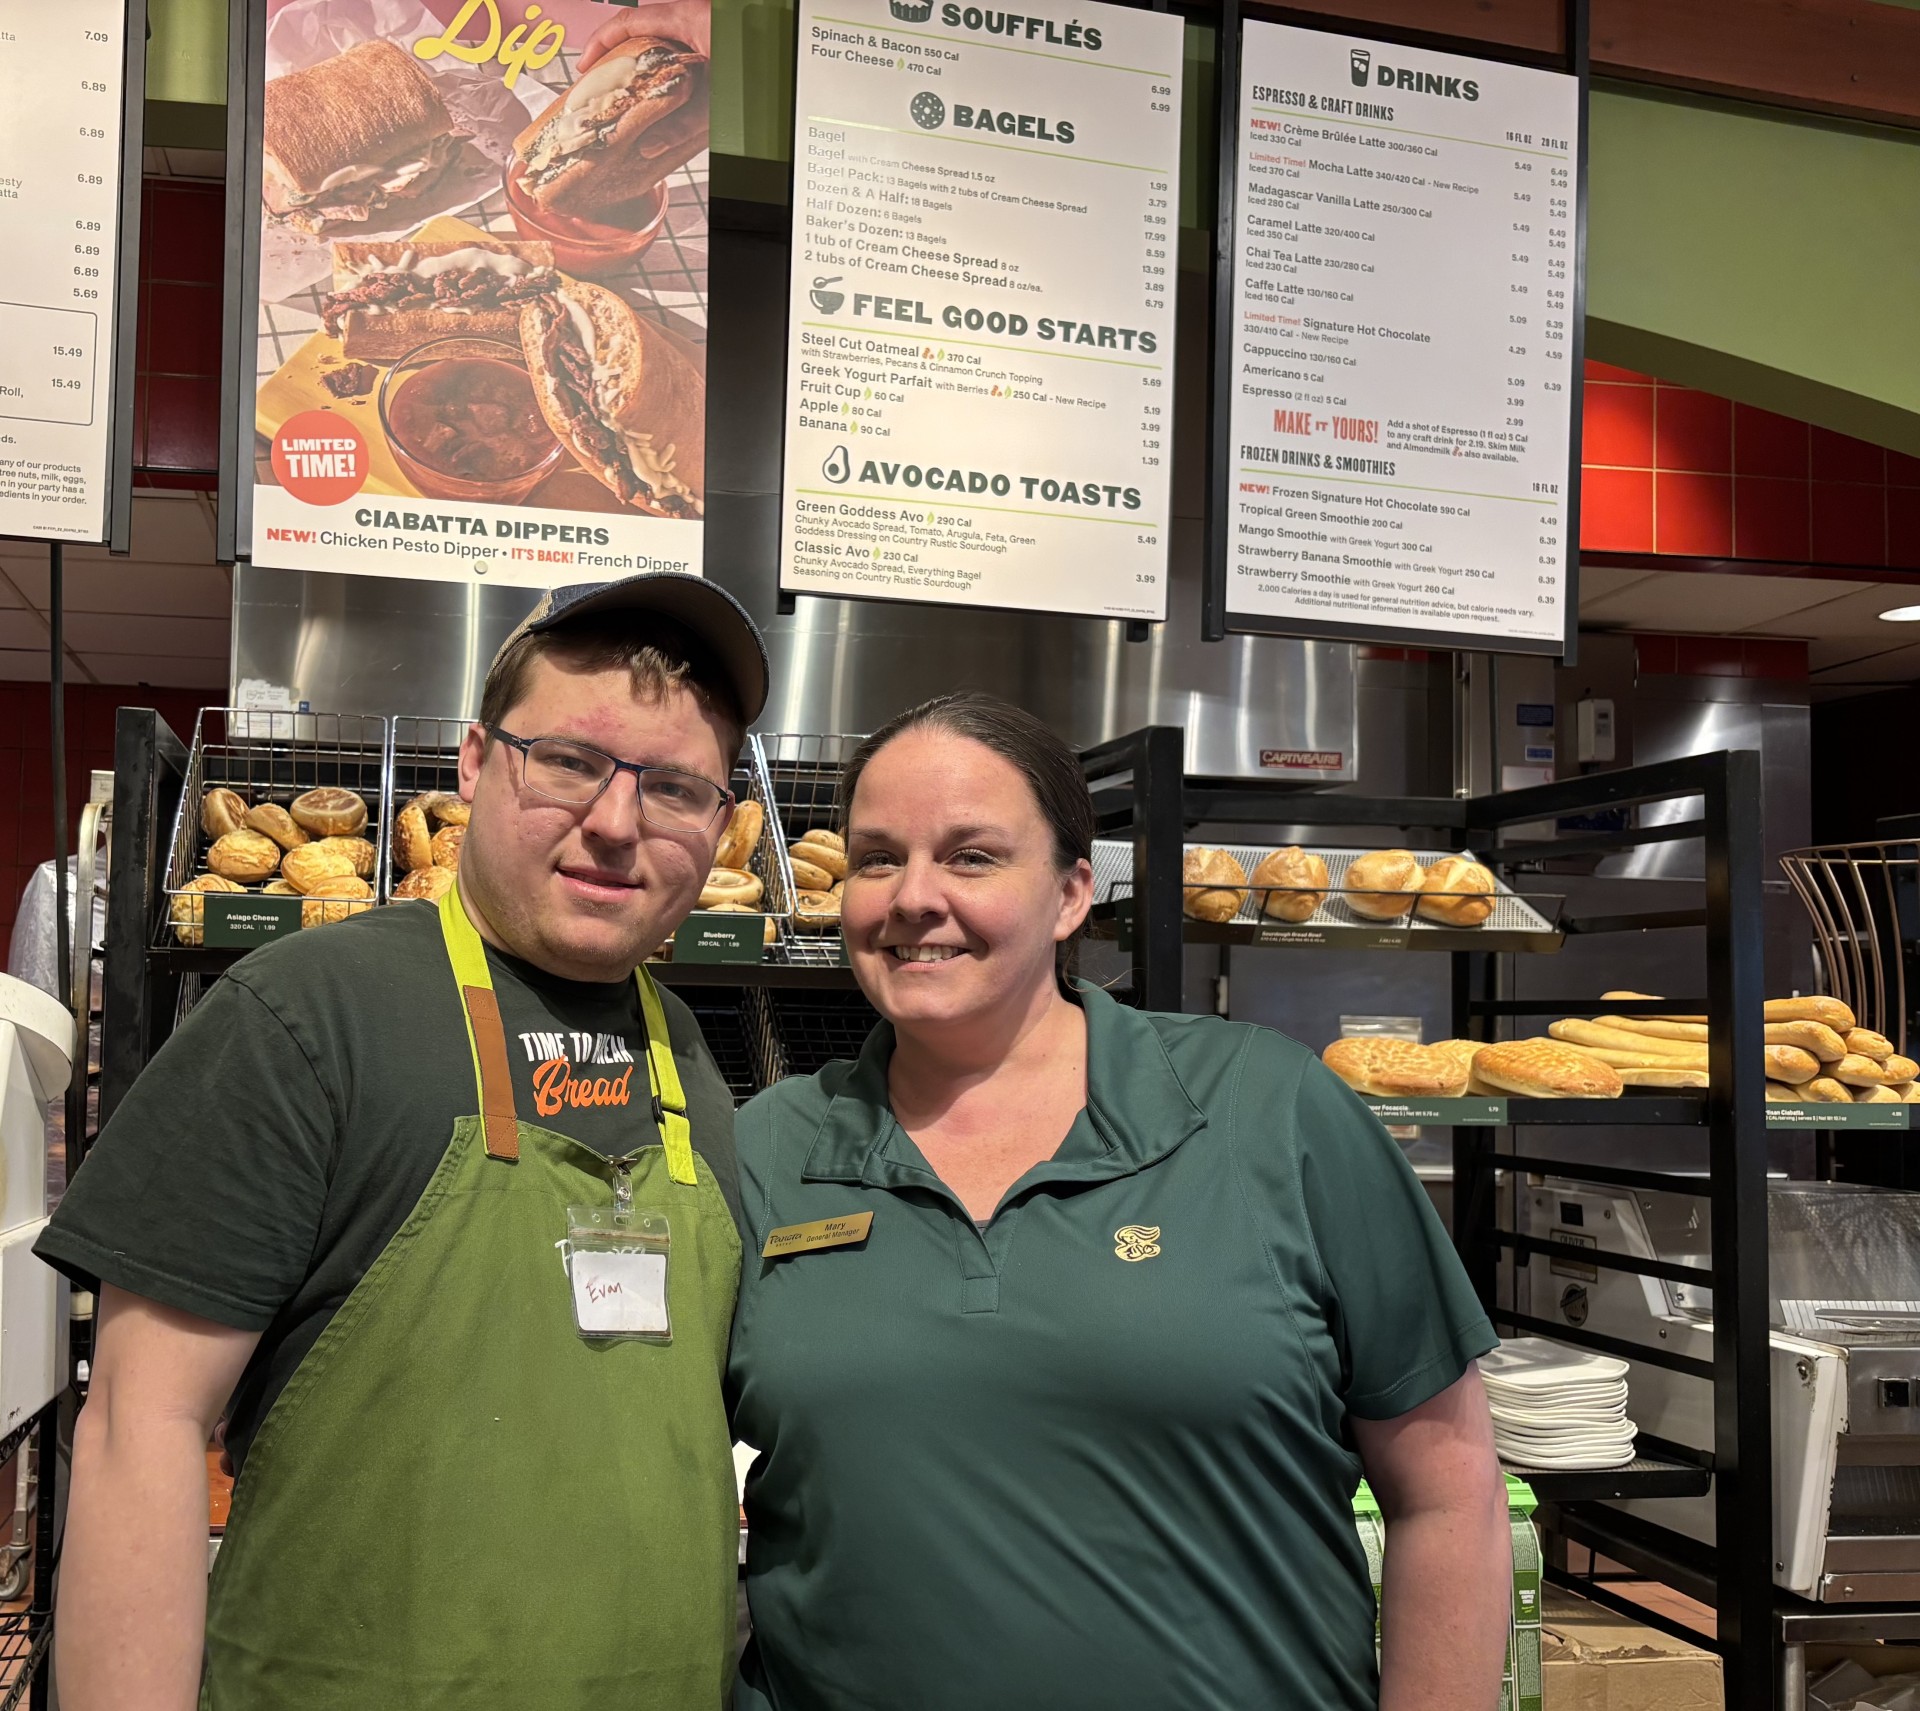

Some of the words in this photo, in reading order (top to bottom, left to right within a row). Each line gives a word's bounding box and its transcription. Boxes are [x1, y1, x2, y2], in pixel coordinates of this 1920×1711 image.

[941, 3, 1102, 51] SOUFFLÉS
[84, 30, 109, 43] 7.09
[811, 26, 864, 46] Spinach
[867, 35, 878, 48] &
[881, 37, 921, 55] Bacon
[924, 47, 942, 58] 550
[943, 51, 959, 61] Cal
[413, 0, 565, 90] Dip
[811, 43, 842, 59] Four
[844, 49, 894, 68] Cheese
[906, 62, 924, 73] 470
[925, 65, 942, 76] Cal
[81, 80, 107, 93] 6.89
[1151, 85, 1171, 96] 6.99
[1377, 64, 1479, 102] DRINKS
[1252, 85, 1305, 107] ESPRESSO
[1307, 94, 1318, 110] &
[1320, 96, 1353, 115] CRAFT
[1355, 101, 1394, 121] DRINKS
[953, 103, 1075, 144] BAGELS
[79, 127, 105, 139] 6.89
[1250, 118, 1281, 132] NEW!
[1283, 123, 1320, 138] Crème
[1358, 134, 1386, 149] Latte
[1424, 147, 1438, 157] Cal
[1514, 161, 1532, 172] 5.49
[1550, 167, 1568, 178] 6.49
[77, 173, 103, 185] 6.89
[75, 220, 101, 231] 6.89
[1247, 214, 1292, 230] Caramel
[1294, 220, 1322, 234] Latte
[1324, 227, 1360, 239] 320/400
[1361, 232, 1375, 242] Cal
[74, 244, 100, 256] 6.89
[805, 232, 810, 243] 1
[814, 233, 836, 246] tub
[838, 237, 853, 249] of
[855, 238, 898, 255] Cream
[901, 245, 950, 262] Cheese
[952, 252, 998, 269] Spread
[1008, 264, 1019, 272] oz
[73, 266, 99, 277] 6.89
[73, 287, 98, 299] 5.69
[853, 292, 933, 325] FEEL
[941, 305, 1028, 336] GOOD
[1036, 317, 1157, 354] STARTS
[52, 346, 83, 357] 15.49
[801, 332, 835, 347] Steel
[838, 336, 862, 351] Cut
[865, 340, 919, 357] Oatmeal
[946, 352, 964, 363] 370
[966, 355, 981, 365] Cal
[800, 347, 821, 357] with
[822, 349, 883, 366] Strawberries,
[885, 356, 918, 369] Pecans
[919, 361, 927, 370] &
[928, 362, 973, 375] Cinnamon
[974, 367, 1007, 380] Crunch
[1008, 372, 1043, 386] Topping
[51, 378, 81, 389] 15.49
[1142, 377, 1162, 388] 5.69
[1273, 409, 1312, 436] MAKE
[1315, 420, 1329, 432] IT
[1332, 415, 1379, 444] YOURS!
[281, 438, 357, 452] LIMITED
[16, 460, 26, 468] of
[26, 461, 41, 469] our
[42, 463, 82, 473] products
[284, 453, 356, 478] TIME!
[1240, 444, 1279, 463] FROZEN
[1281, 449, 1321, 468] DRINKS
[1323, 454, 1333, 469] &
[1335, 455, 1395, 476] SMOOTHIES
[18, 471, 39, 480] nuts,
[41, 473, 61, 483] milk,
[63, 476, 87, 485] eggs,
[858, 460, 1011, 496] AVOCADO
[1019, 476, 1141, 510] TOASTS
[8, 480, 16, 488] in
[17, 482, 37, 490] your
[38, 483, 61, 493] party
[62, 484, 78, 494] has
[32, 492, 40, 500] in
[41, 494, 60, 503] your
[62, 495, 87, 505] order.
[1239, 482, 1270, 494] NEW!
[1272, 486, 1309, 499] Frozen
[1311, 490, 1363, 505] Signature
[1364, 495, 1383, 508] Hot
[1385, 498, 1438, 513] Chocolate
[1440, 505, 1456, 515] 590
[1456, 507, 1470, 517] Cal
[795, 499, 835, 514] Green
[838, 503, 896, 520] Goddess
[899, 509, 924, 523] Avo
[936, 516, 955, 526] 290
[956, 517, 972, 527] Cal
[1239, 502, 1283, 517] Tropical
[1284, 507, 1317, 521] Green
[1319, 511, 1370, 526] Smoothie
[1371, 518, 1388, 528] 200
[1389, 520, 1403, 530] Cal
[354, 508, 489, 537] CIABATTA
[495, 519, 610, 546] DIPPERS
[1539, 516, 1557, 526] 4.49
[1137, 535, 1157, 545] 5.49
[266, 527, 317, 544] NEW!
[320, 530, 388, 550] Chicken
[392, 537, 440, 554] Pesto
[443, 541, 499, 560] Dipper
[537, 549, 575, 564] BACK!
[577, 551, 633, 569] French
[636, 555, 689, 573] Dipper
[794, 540, 842, 556] Classic
[845, 545, 870, 558] Avo
[882, 551, 901, 561] 230
[902, 553, 918, 563] Cal
[1135, 574, 1156, 584] 3.99
[226, 913, 251, 922] Asiago
[252, 914, 279, 922] Cheese
[703, 931, 736, 940] Blueberry
[518, 1032, 569, 1062] TIME
[569, 1032, 593, 1063] TO
[532, 1054, 634, 1118] Bread
[824, 1222, 847, 1232] Mary
[806, 1233, 831, 1243] General
[832, 1228, 860, 1238] Manager
